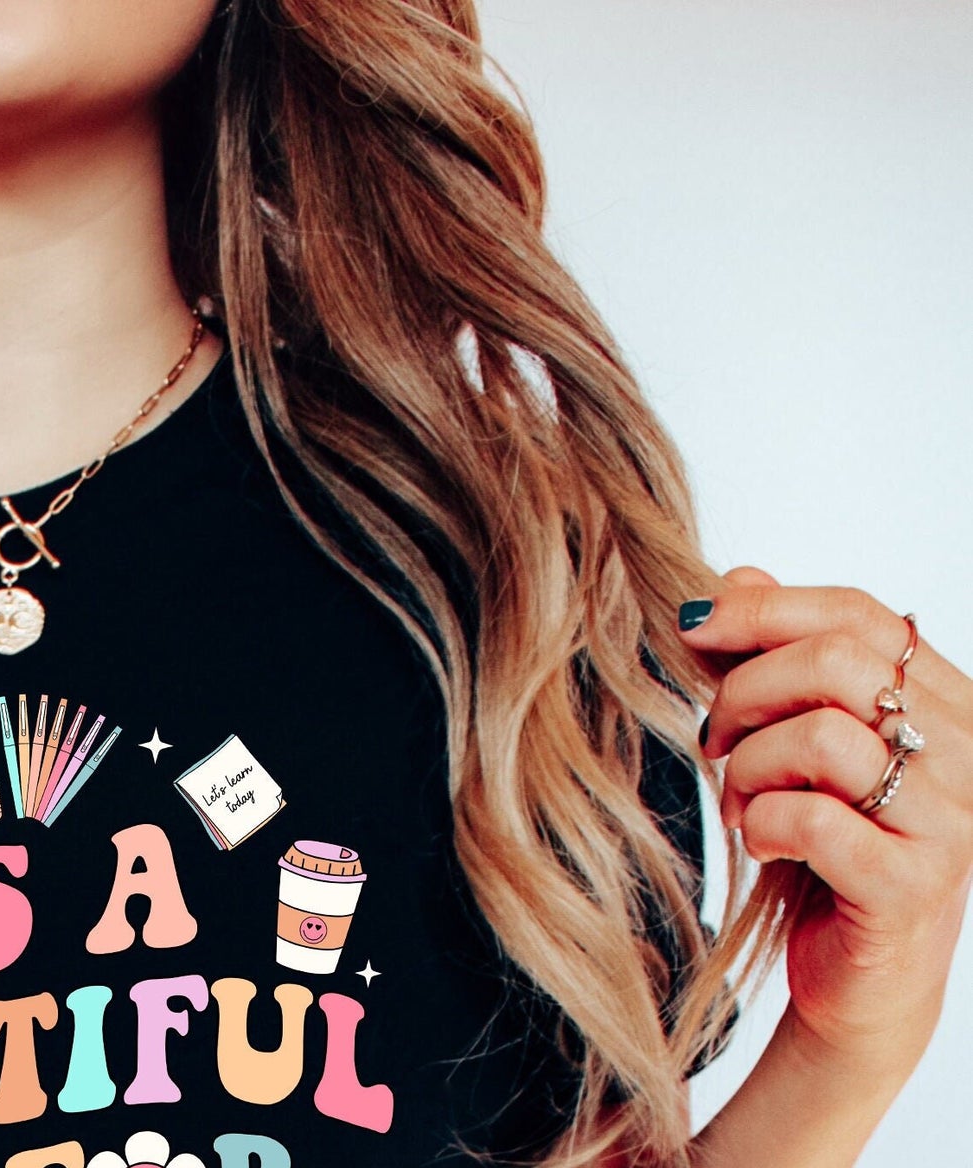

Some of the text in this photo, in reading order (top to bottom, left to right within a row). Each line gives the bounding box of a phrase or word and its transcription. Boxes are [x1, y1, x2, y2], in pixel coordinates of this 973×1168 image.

[201, 765, 253, 807] Let's learn
[225, 789, 256, 813] today
[84, 823, 198, 954] A
